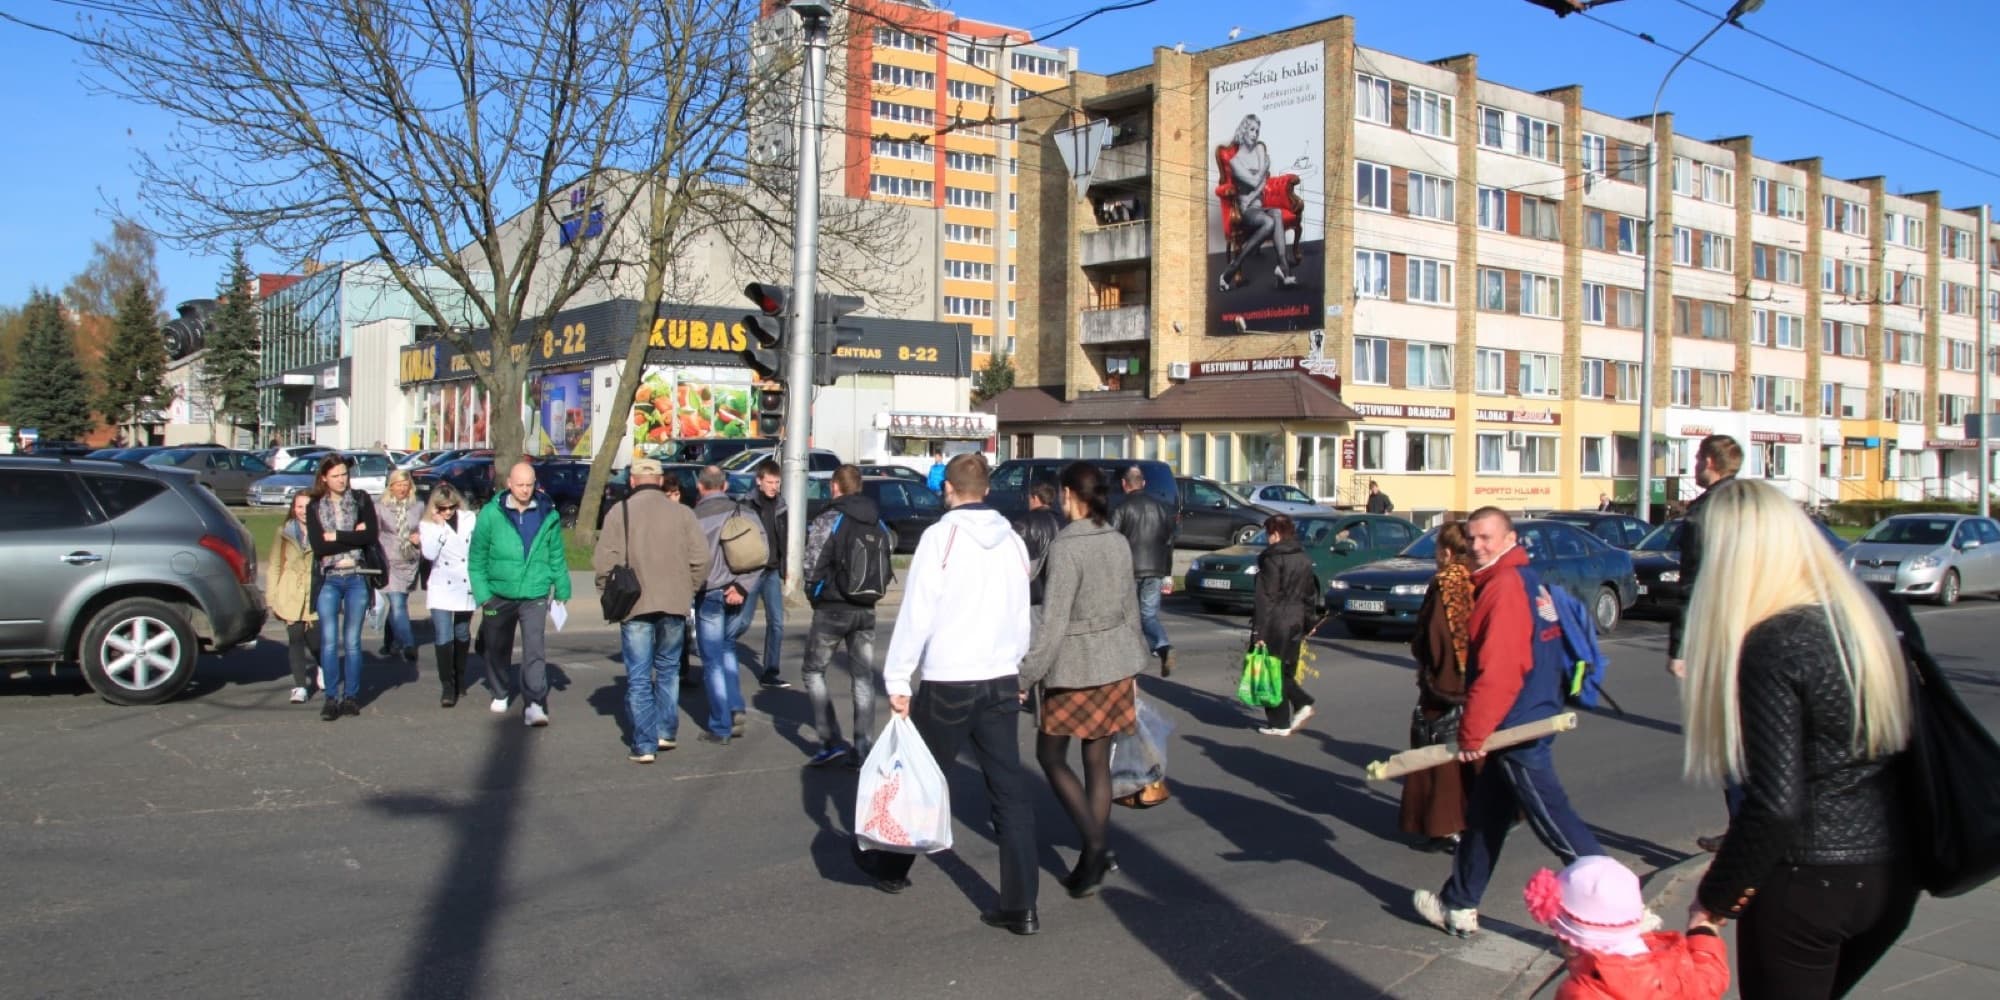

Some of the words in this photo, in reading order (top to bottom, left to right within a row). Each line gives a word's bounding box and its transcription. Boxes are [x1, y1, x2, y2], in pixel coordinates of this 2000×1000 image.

[1281, 59, 1319, 80] baldai
[400, 345, 436, 384] KUBAS
[543, 322, 586, 358] 8-22
[832, 346, 882, 360] ENTRAS
[898, 346, 938, 361] 8-22
[1200, 361, 1248, 374] VESTUVINIAI
[1252, 357, 1295, 371] DRABUŽIAI
[1474, 486, 1512, 495] SPORTO
